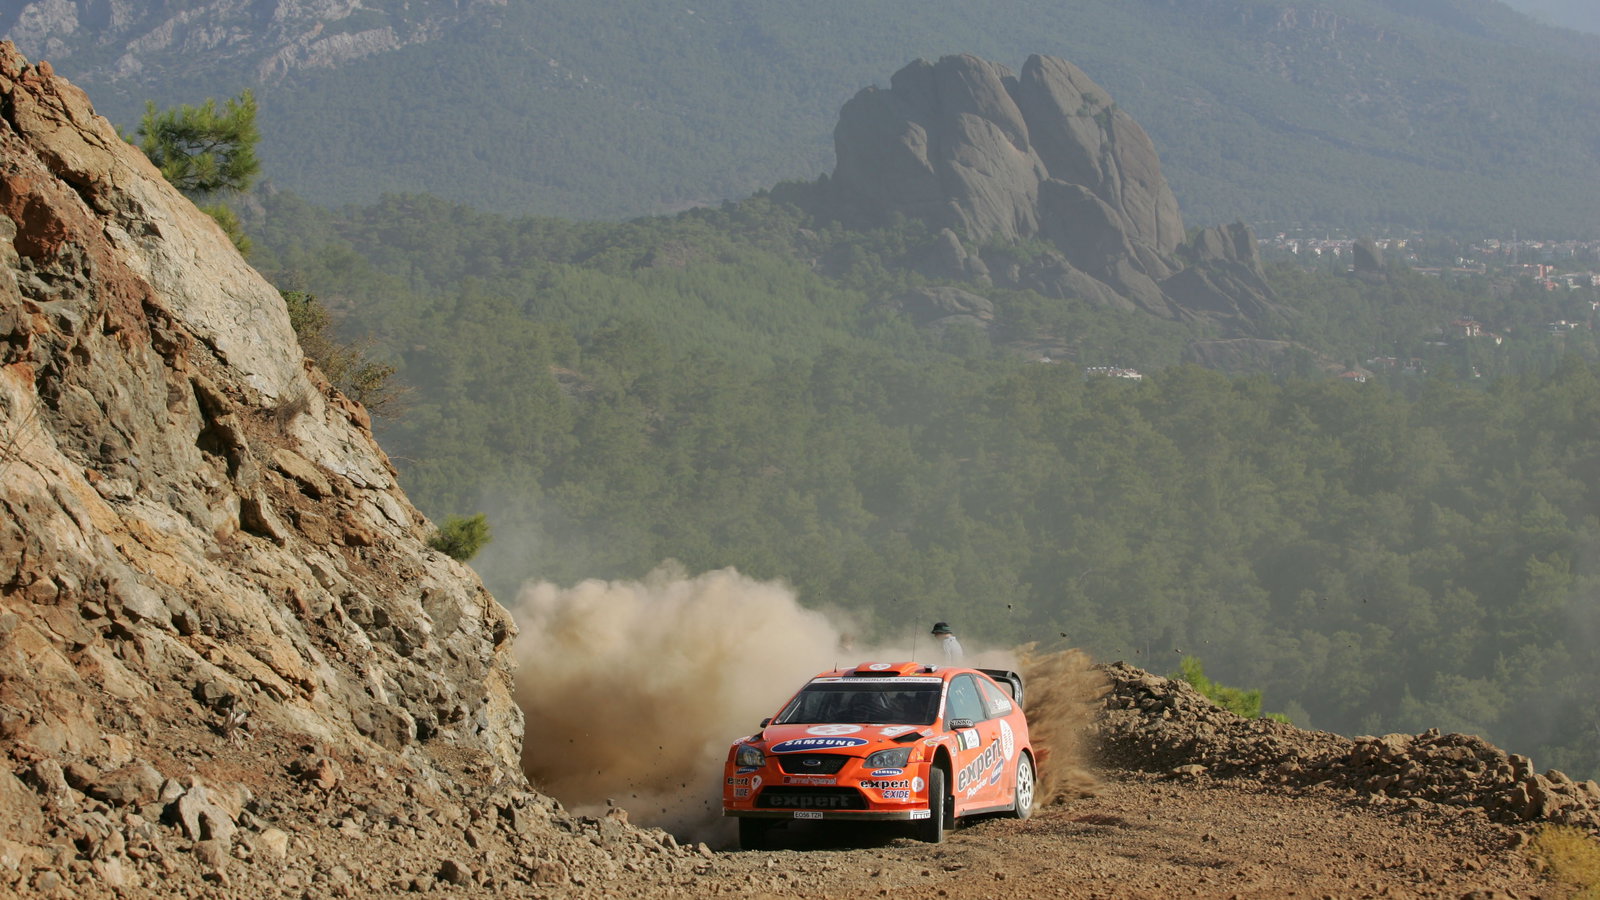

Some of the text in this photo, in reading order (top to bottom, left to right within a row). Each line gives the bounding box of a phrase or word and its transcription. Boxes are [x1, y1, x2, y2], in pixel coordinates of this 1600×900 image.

[958, 738, 1001, 792] expert
[860, 780, 909, 789] expert
[882, 790, 910, 799] EXIDE
[770, 795, 849, 808] expert
